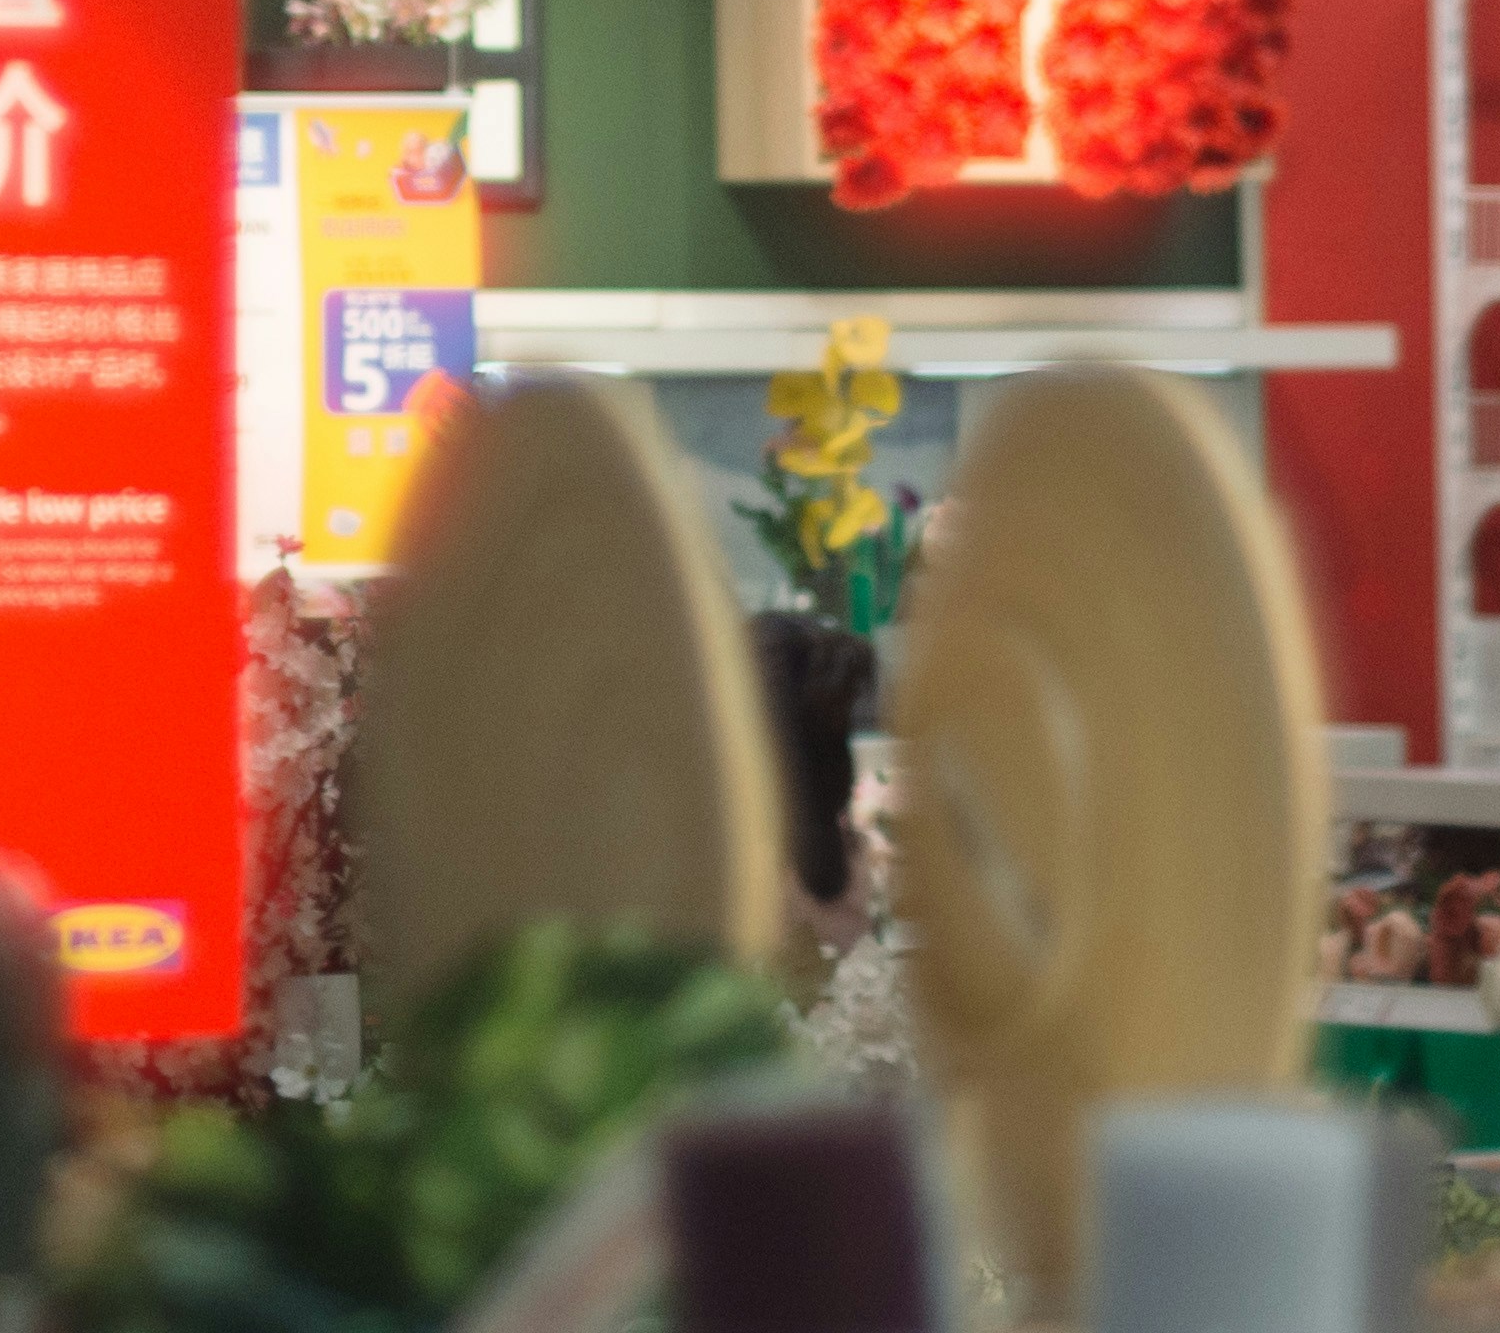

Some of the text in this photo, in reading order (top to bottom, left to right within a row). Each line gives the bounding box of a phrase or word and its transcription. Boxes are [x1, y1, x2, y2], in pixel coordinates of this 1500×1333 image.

[25, 486, 85, 526] low
[88, 486, 172, 532] price
[66, 925, 168, 954] KEA
